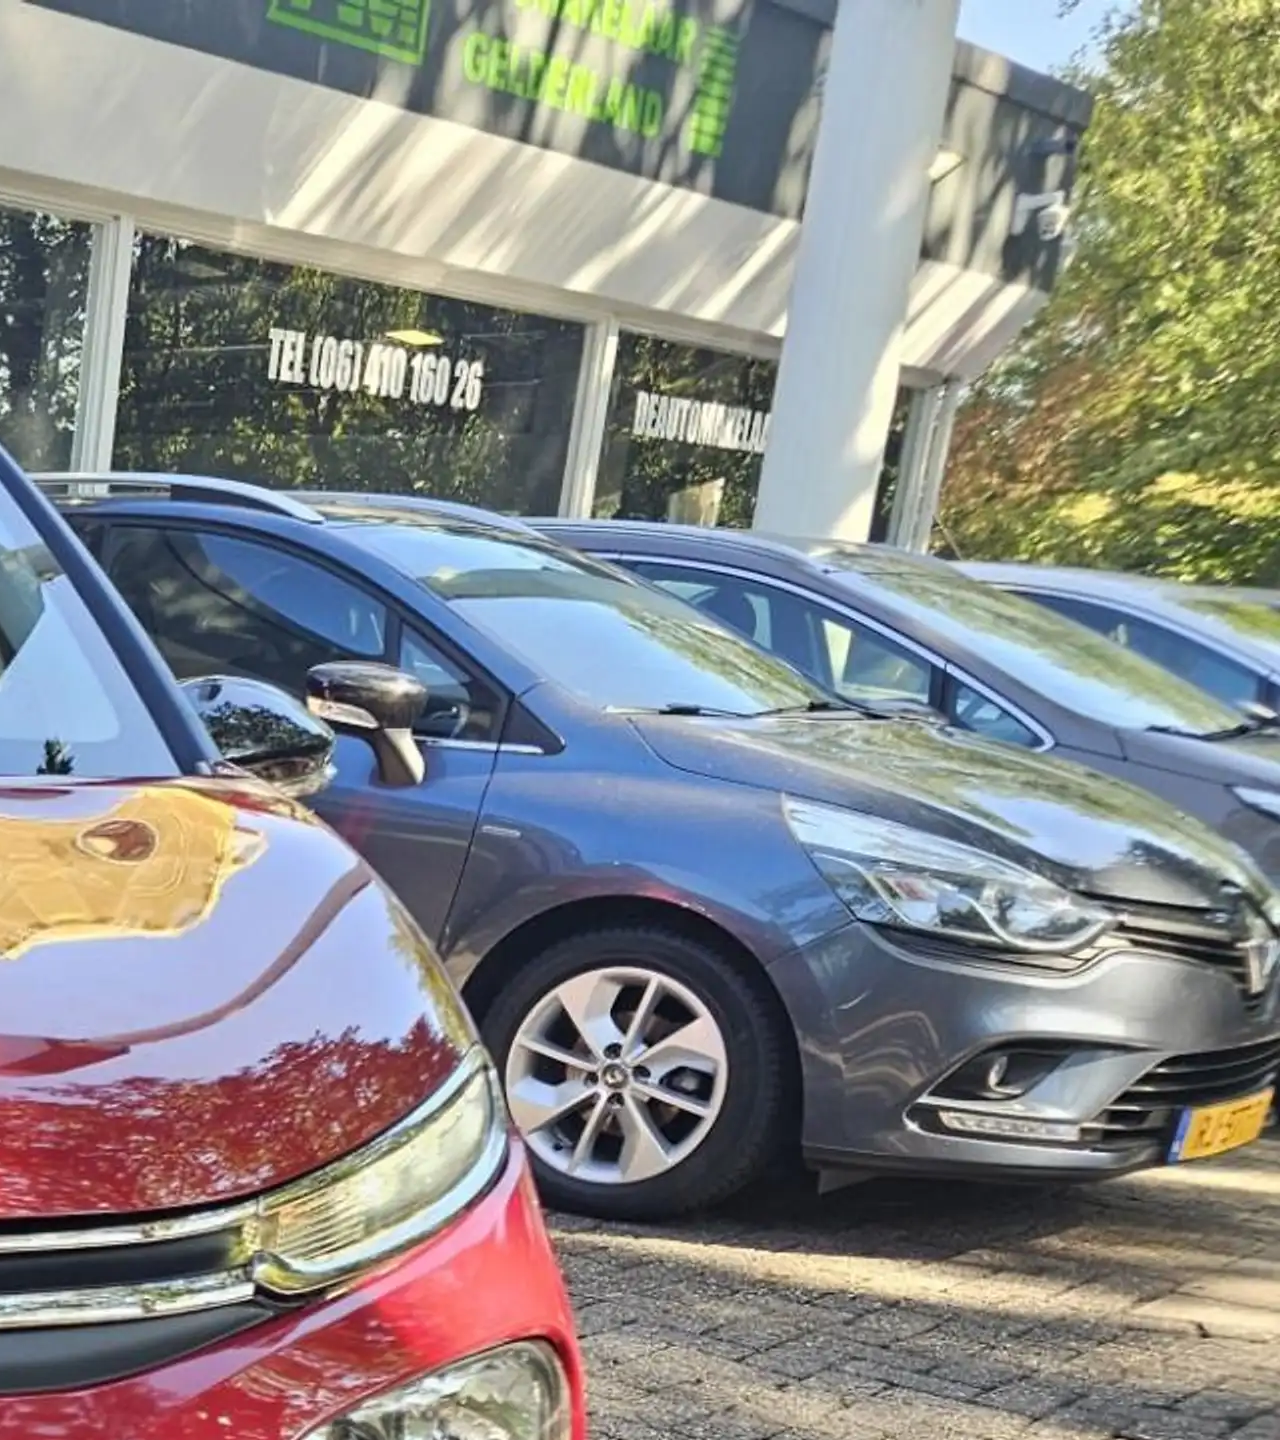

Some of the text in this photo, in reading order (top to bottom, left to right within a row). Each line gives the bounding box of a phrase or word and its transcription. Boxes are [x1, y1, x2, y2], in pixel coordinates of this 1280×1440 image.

[268, 327, 484, 411] TEL (06) 410 160 26
